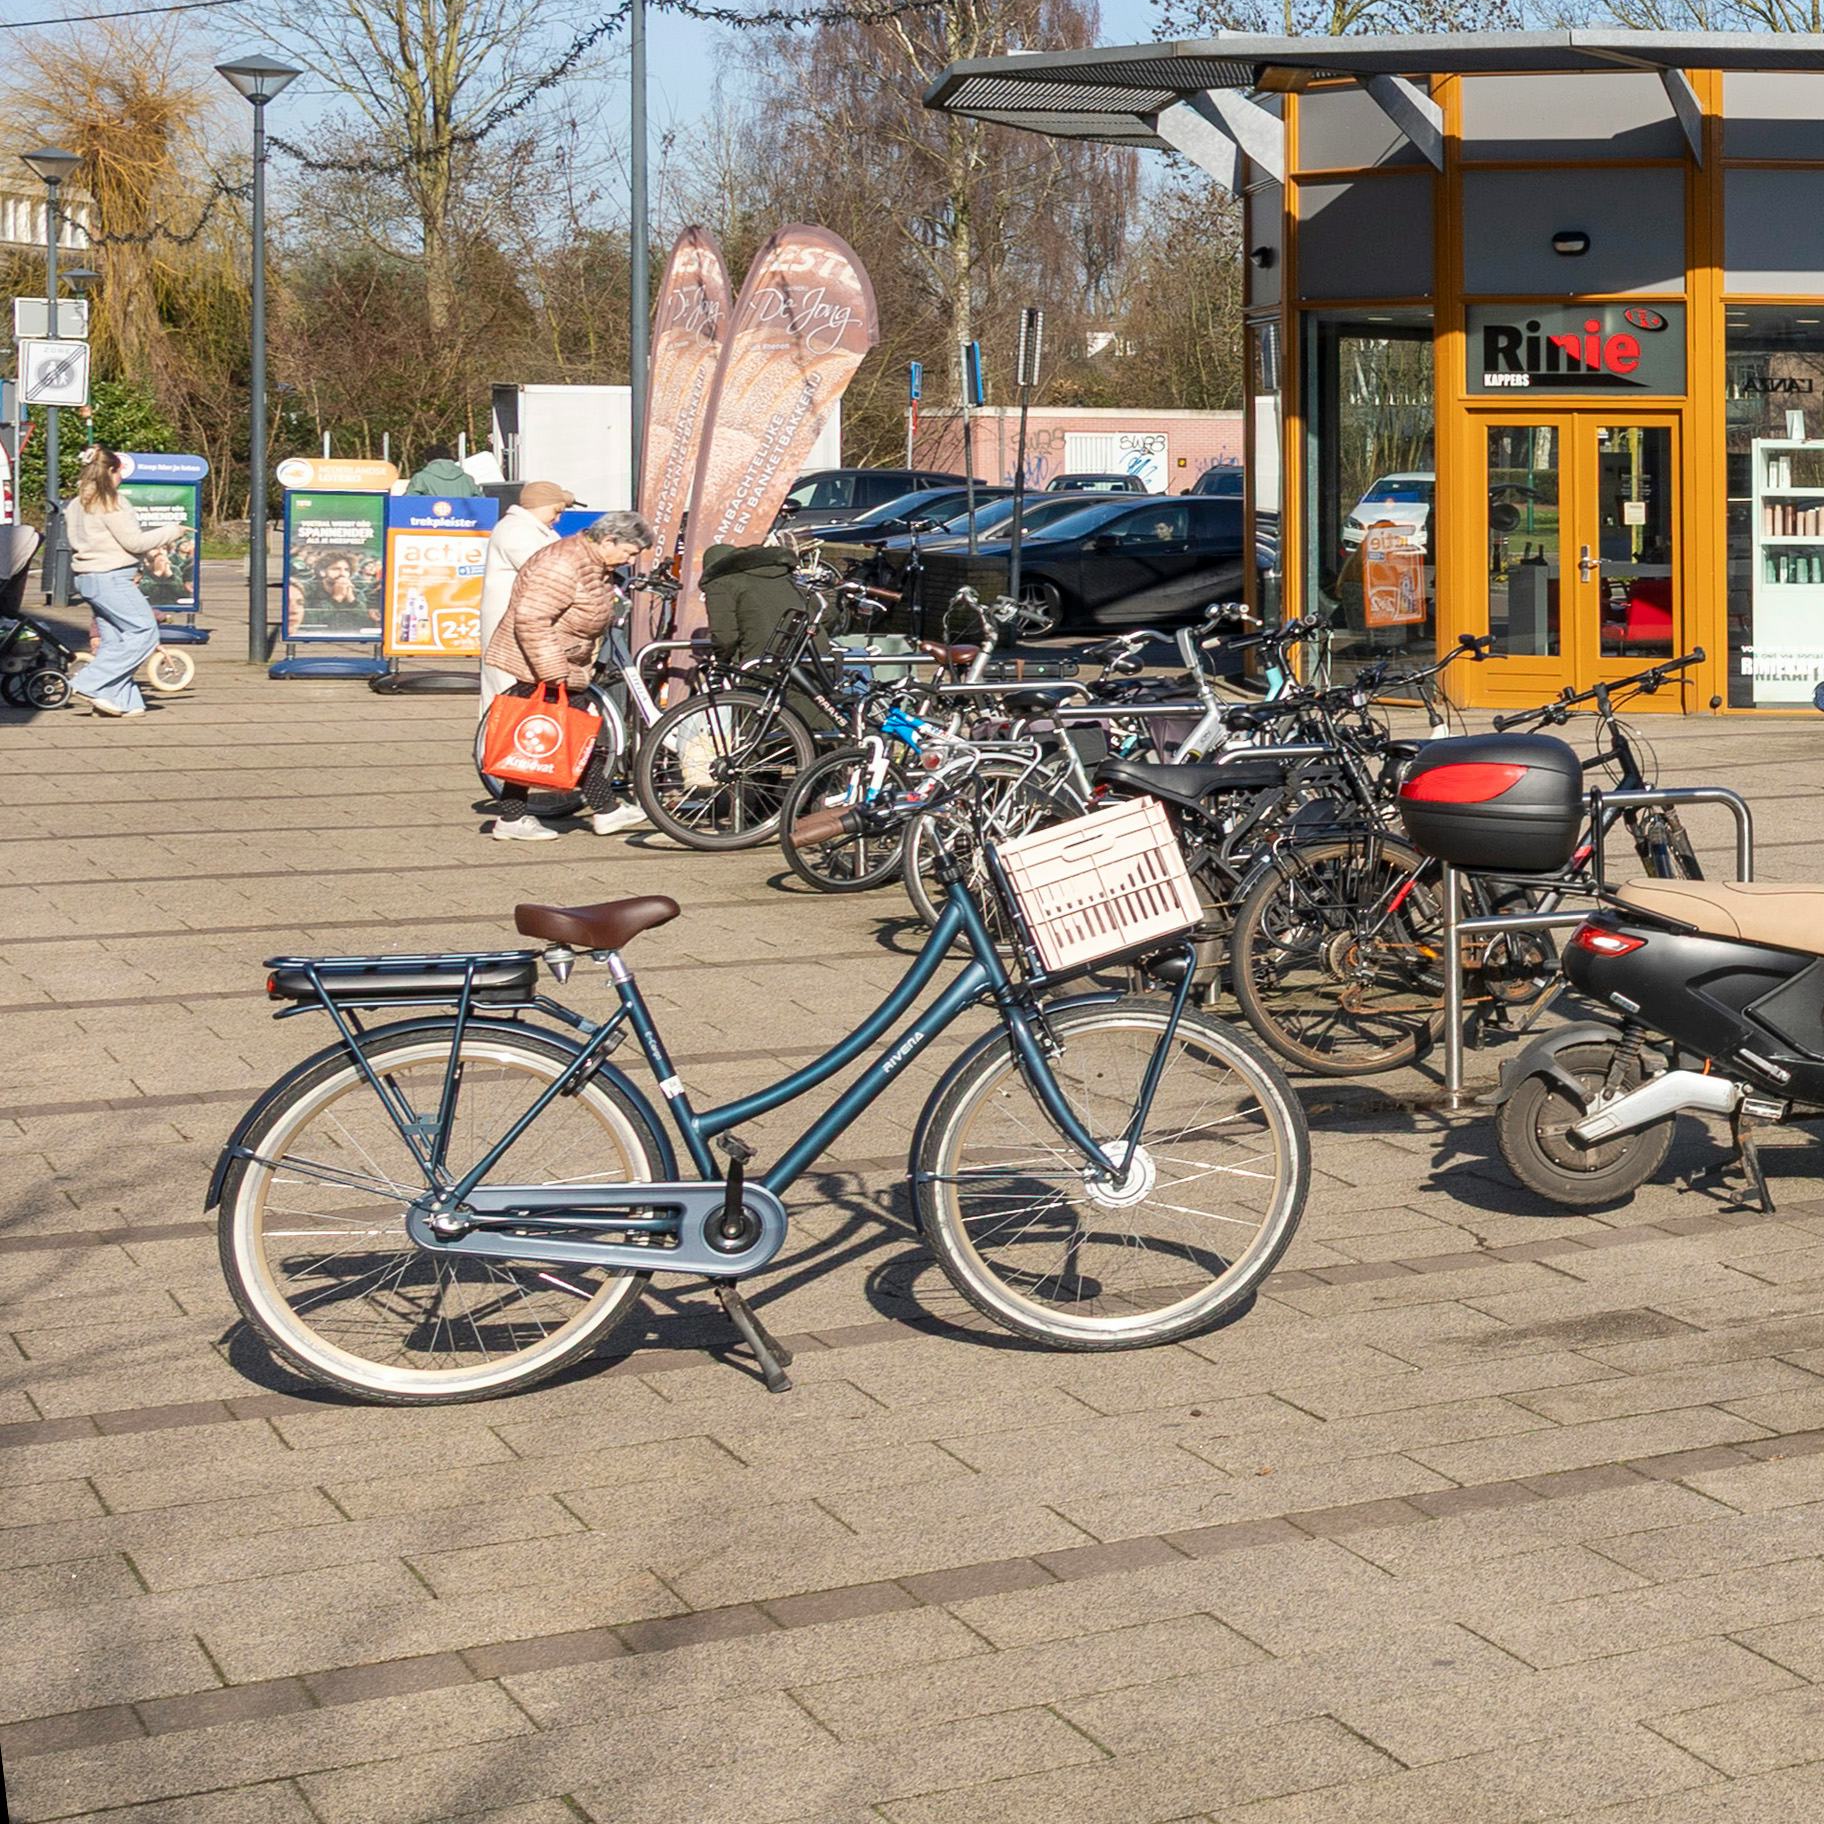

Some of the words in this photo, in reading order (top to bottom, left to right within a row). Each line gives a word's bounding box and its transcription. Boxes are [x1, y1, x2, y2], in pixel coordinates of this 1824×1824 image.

[748, 288, 797, 322] De
[786, 287, 863, 354] Jong
[1483, 319, 1641, 374] Rinie
[1483, 373, 1530, 387] KAPPERS
[733, 511, 751, 535] EN
[749, 372, 823, 509] BANKETBAKKERIJ
[713, 412, 784, 544] AMBACHTELIJKE
[410, 516, 477, 529] trekpleister
[664, 502, 673, 523] EN
[298, 527, 374, 538] SPANNENDER
[404, 541, 482, 563] actie
[441, 620, 480, 639] 2+2
[882, 1031, 925, 1074] RIVENA
